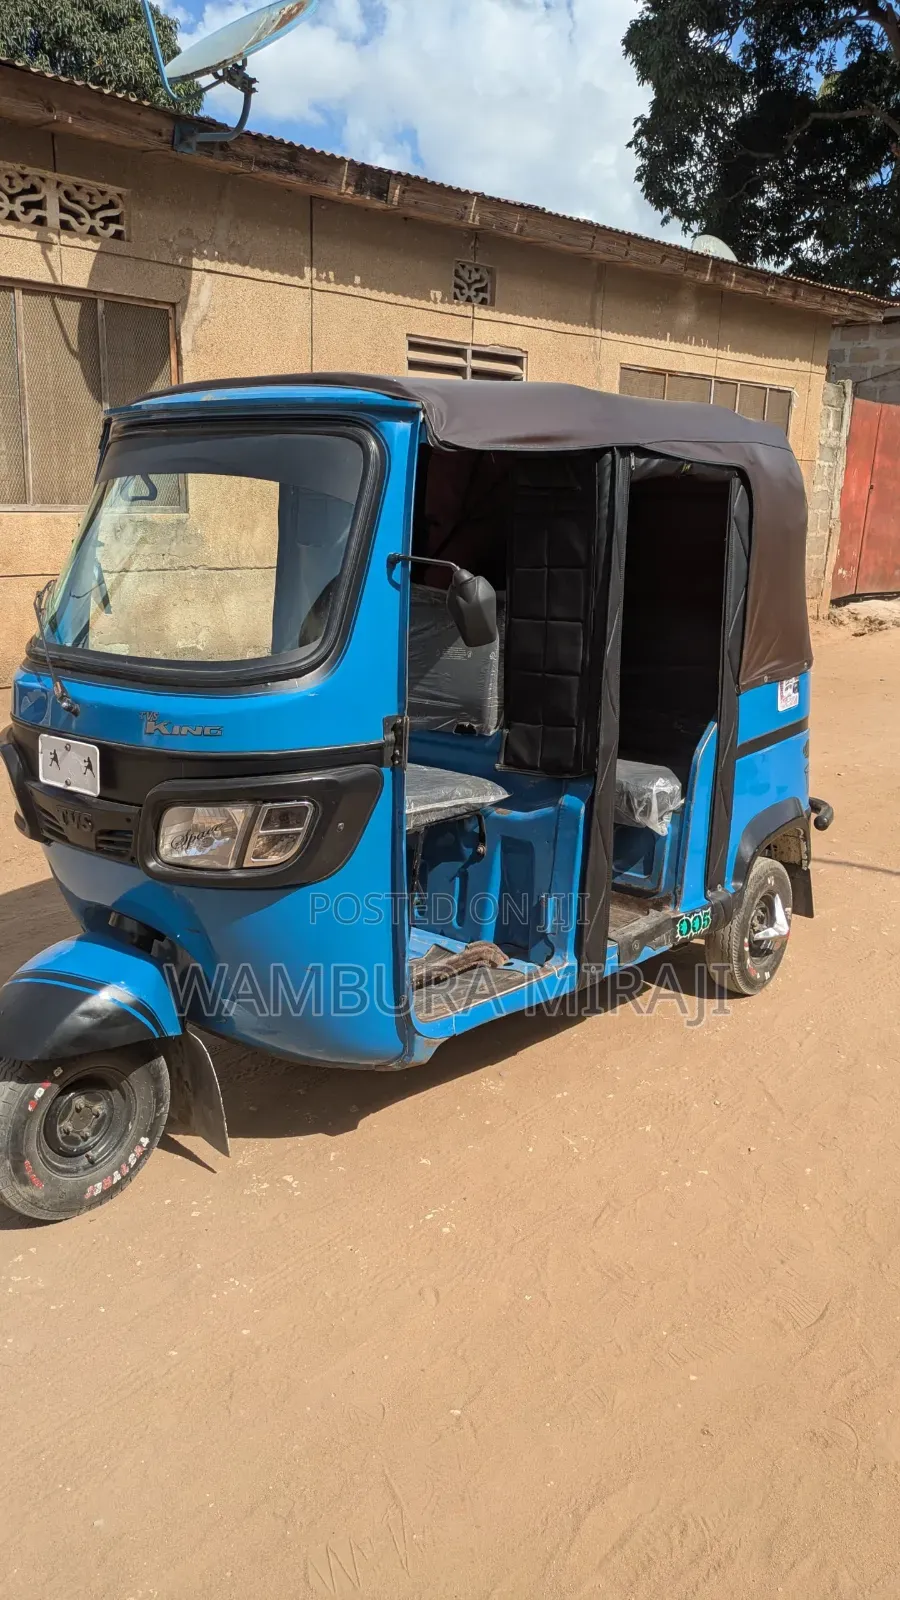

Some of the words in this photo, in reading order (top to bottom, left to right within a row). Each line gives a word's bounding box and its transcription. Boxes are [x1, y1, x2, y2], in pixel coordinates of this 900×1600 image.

[138, 711, 159, 722] TVS
[144, 720, 224, 736] KING
[57, 806, 94, 832] TVS
